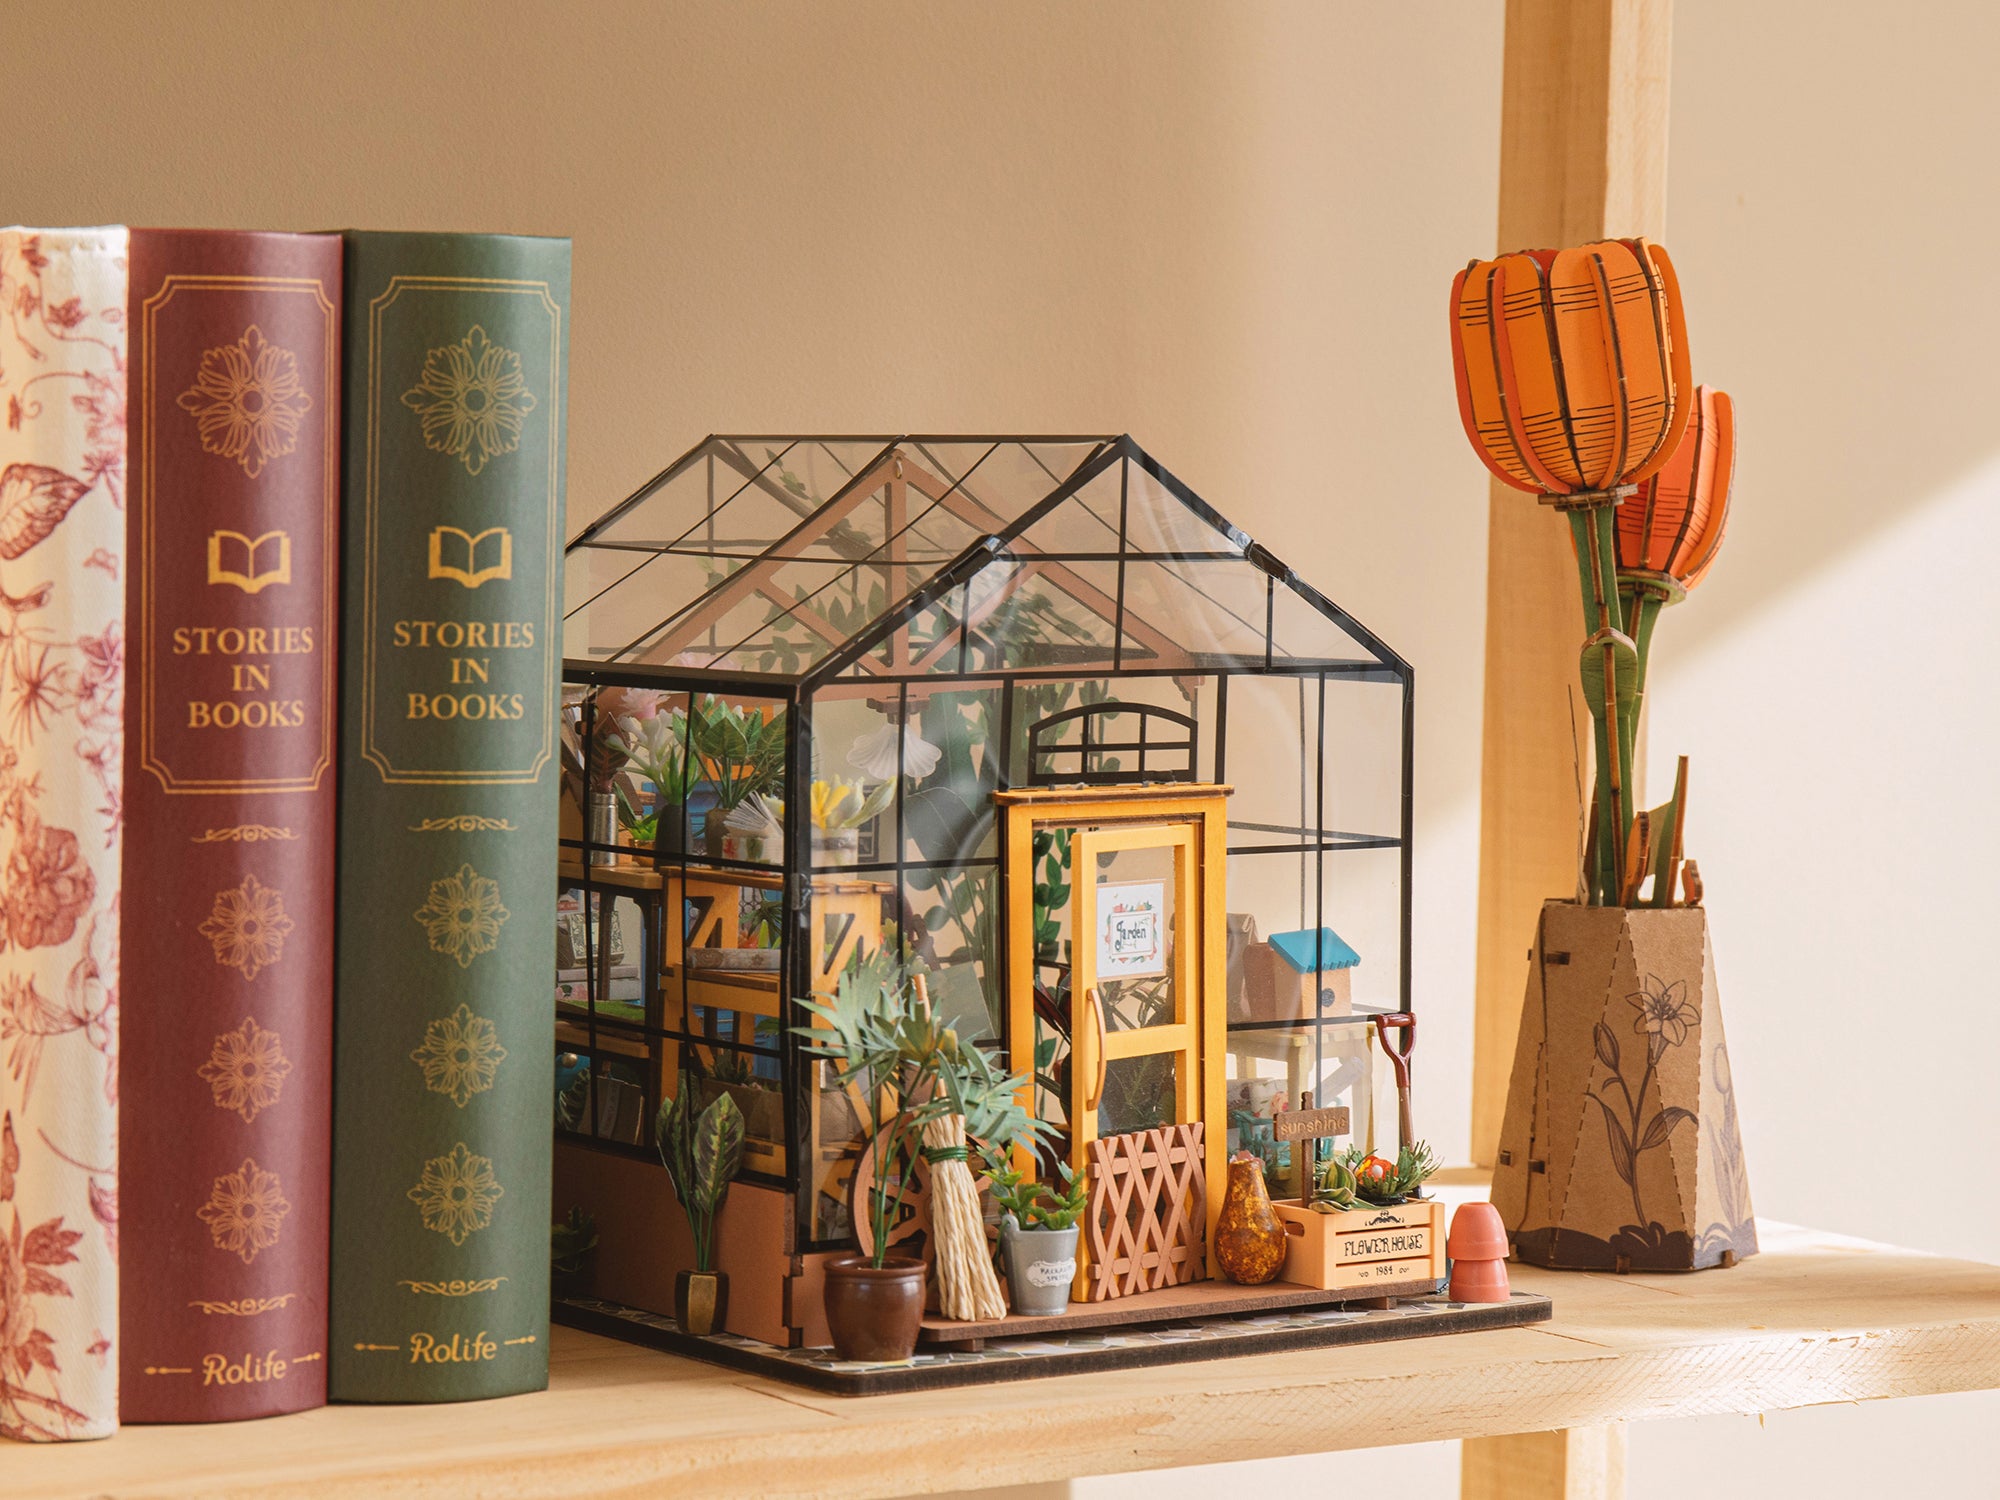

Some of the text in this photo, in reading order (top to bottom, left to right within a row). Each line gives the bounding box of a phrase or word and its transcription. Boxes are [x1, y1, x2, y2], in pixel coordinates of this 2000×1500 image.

[173, 627, 314, 655] STORIES
[394, 620, 535, 649] STORIES
[233, 664, 270, 691] IN
[451, 658, 490, 684] IN
[188, 700, 305, 728] BOOKS
[407, 693, 525, 721] BOOKS
[1280, 1114, 1346, 1135] sunshine
[1344, 1234, 1423, 1256] FLOWER HOUSE
[410, 1331, 498, 1364] Rolife
[202, 1350, 288, 1386] Rolife
